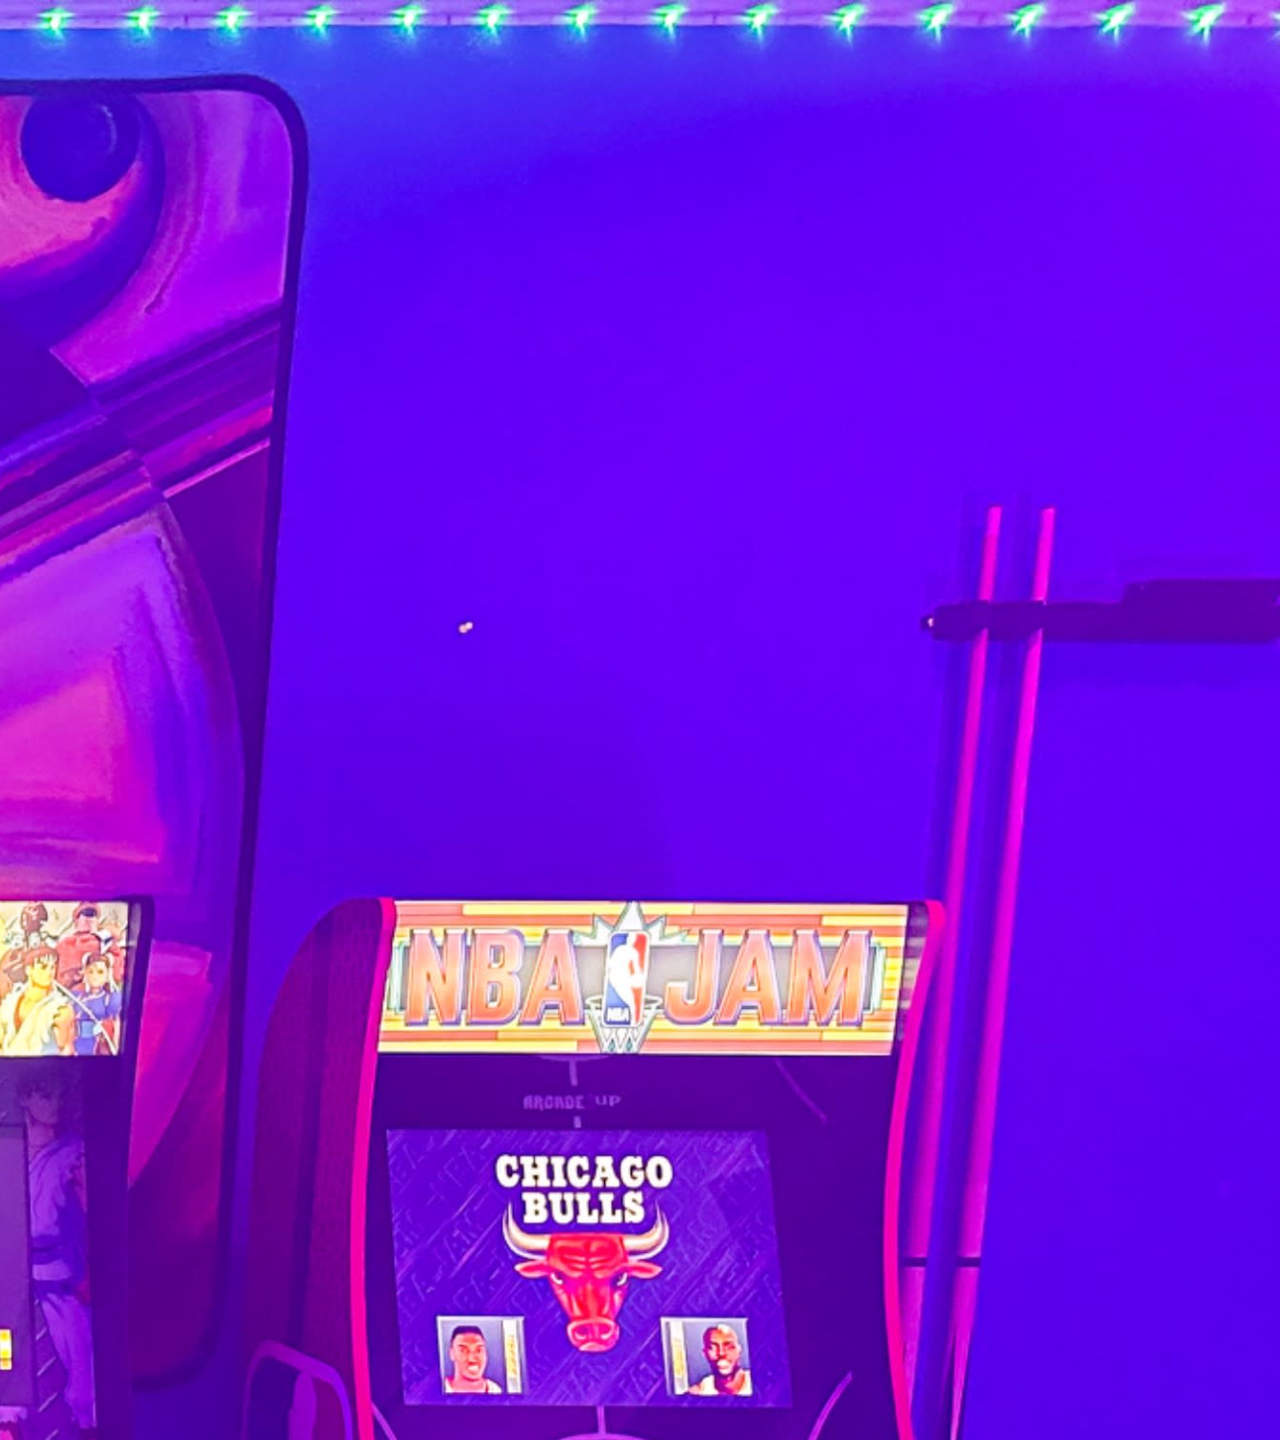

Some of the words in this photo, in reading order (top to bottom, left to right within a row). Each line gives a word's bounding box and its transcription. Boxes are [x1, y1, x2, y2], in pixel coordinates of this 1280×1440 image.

[405, 928, 586, 1027] NBA
[665, 928, 873, 1027] JAM
[496, 1154, 673, 1188] CHICAGO
[522, 1190, 645, 1224] BULLS
